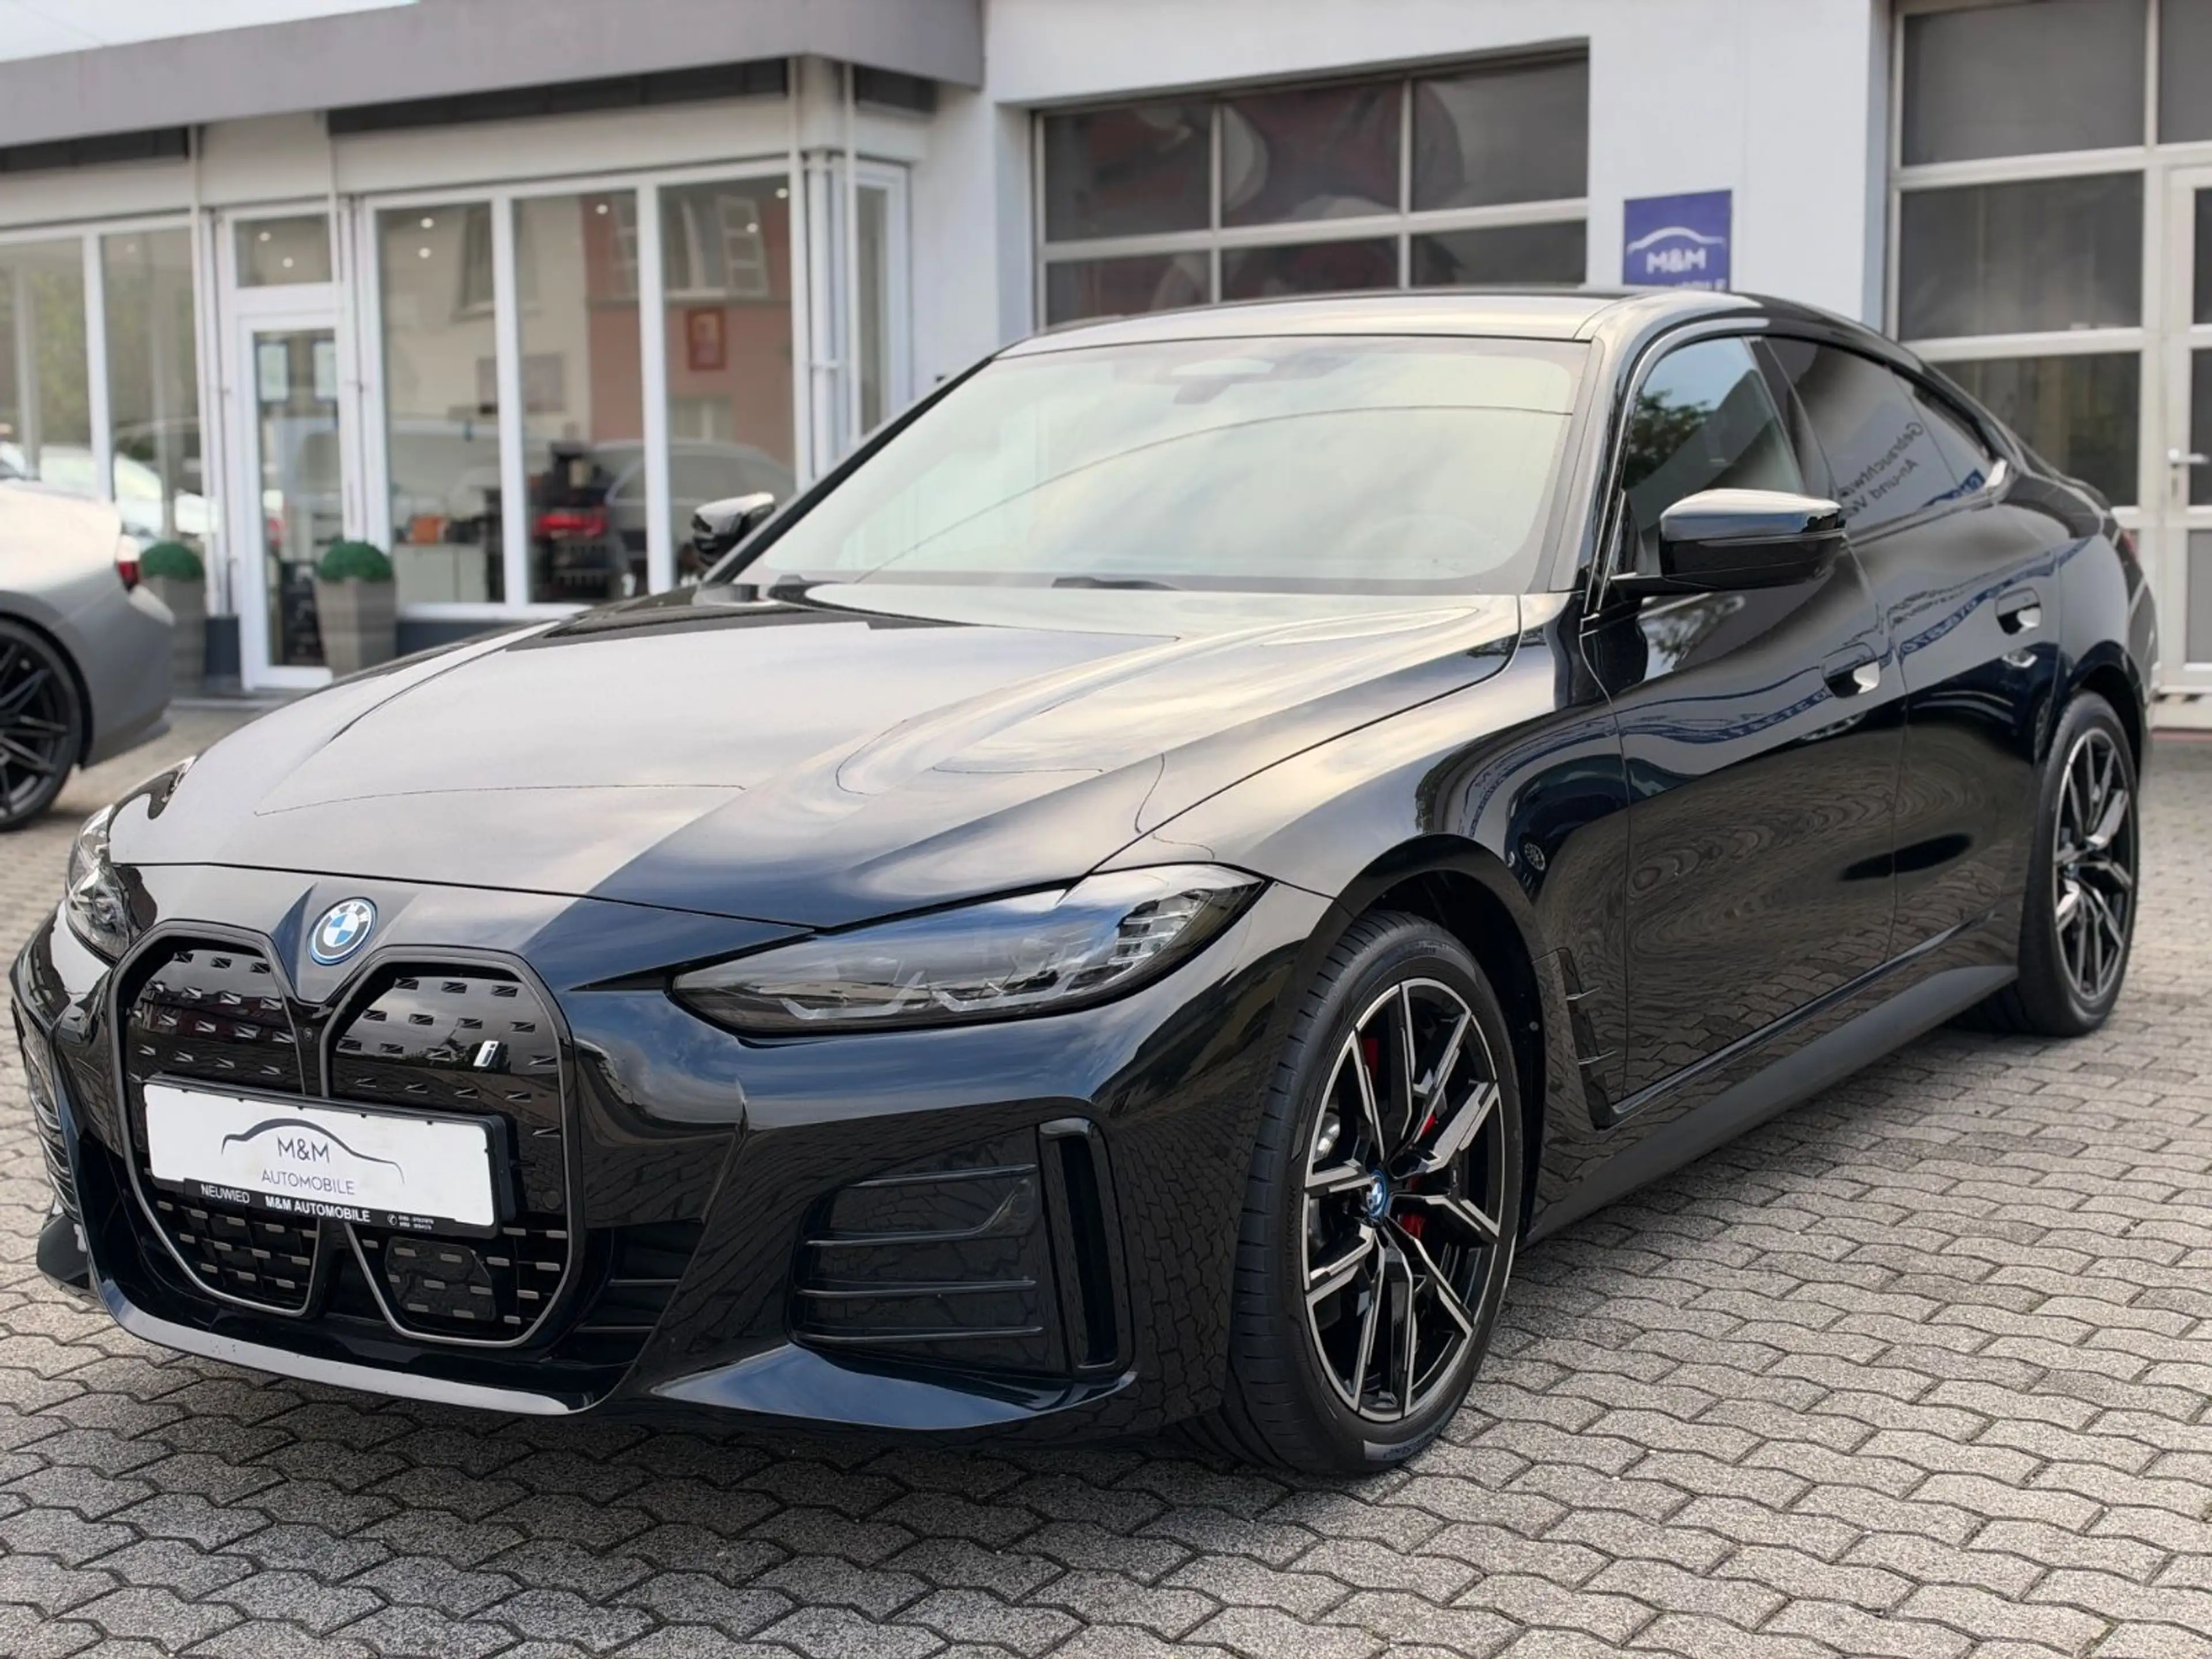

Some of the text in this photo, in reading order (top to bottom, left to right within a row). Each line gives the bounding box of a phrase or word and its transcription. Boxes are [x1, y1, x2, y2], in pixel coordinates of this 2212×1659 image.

[277, 1135, 330, 1164] M&M
[261, 1169, 355, 1195] AUTOMOBILE
[200, 1183, 372, 1223] NEUWIED M&M AUTOMOBILE
